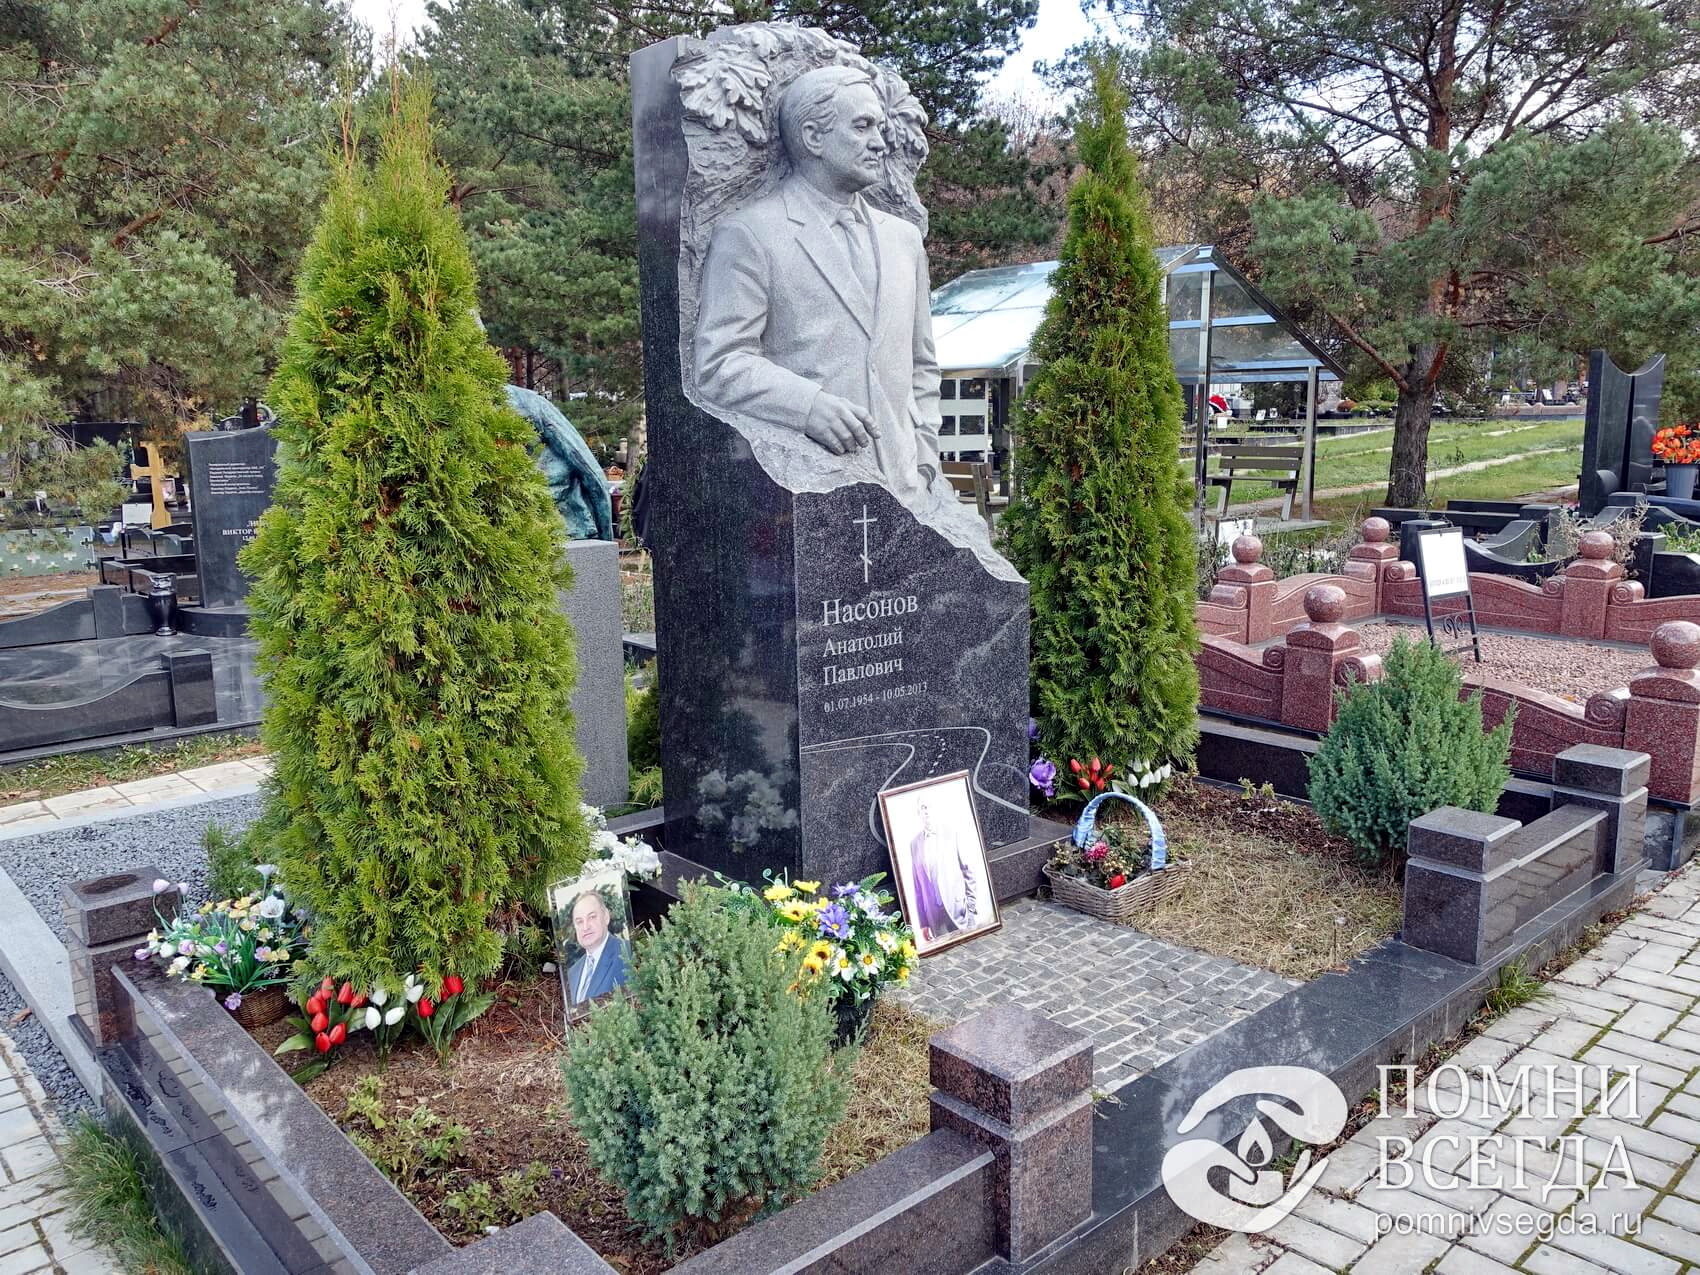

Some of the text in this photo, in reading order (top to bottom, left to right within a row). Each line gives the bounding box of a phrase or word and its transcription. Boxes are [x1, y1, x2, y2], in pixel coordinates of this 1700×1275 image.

[821, 595, 919, 627] Насонов
[822, 626, 903, 658] Анатолий
[823, 658, 903, 686] Павлович
[823, 692, 874, 713] 01.07.1954
[882, 681, 928, 701] 10.05.2013
